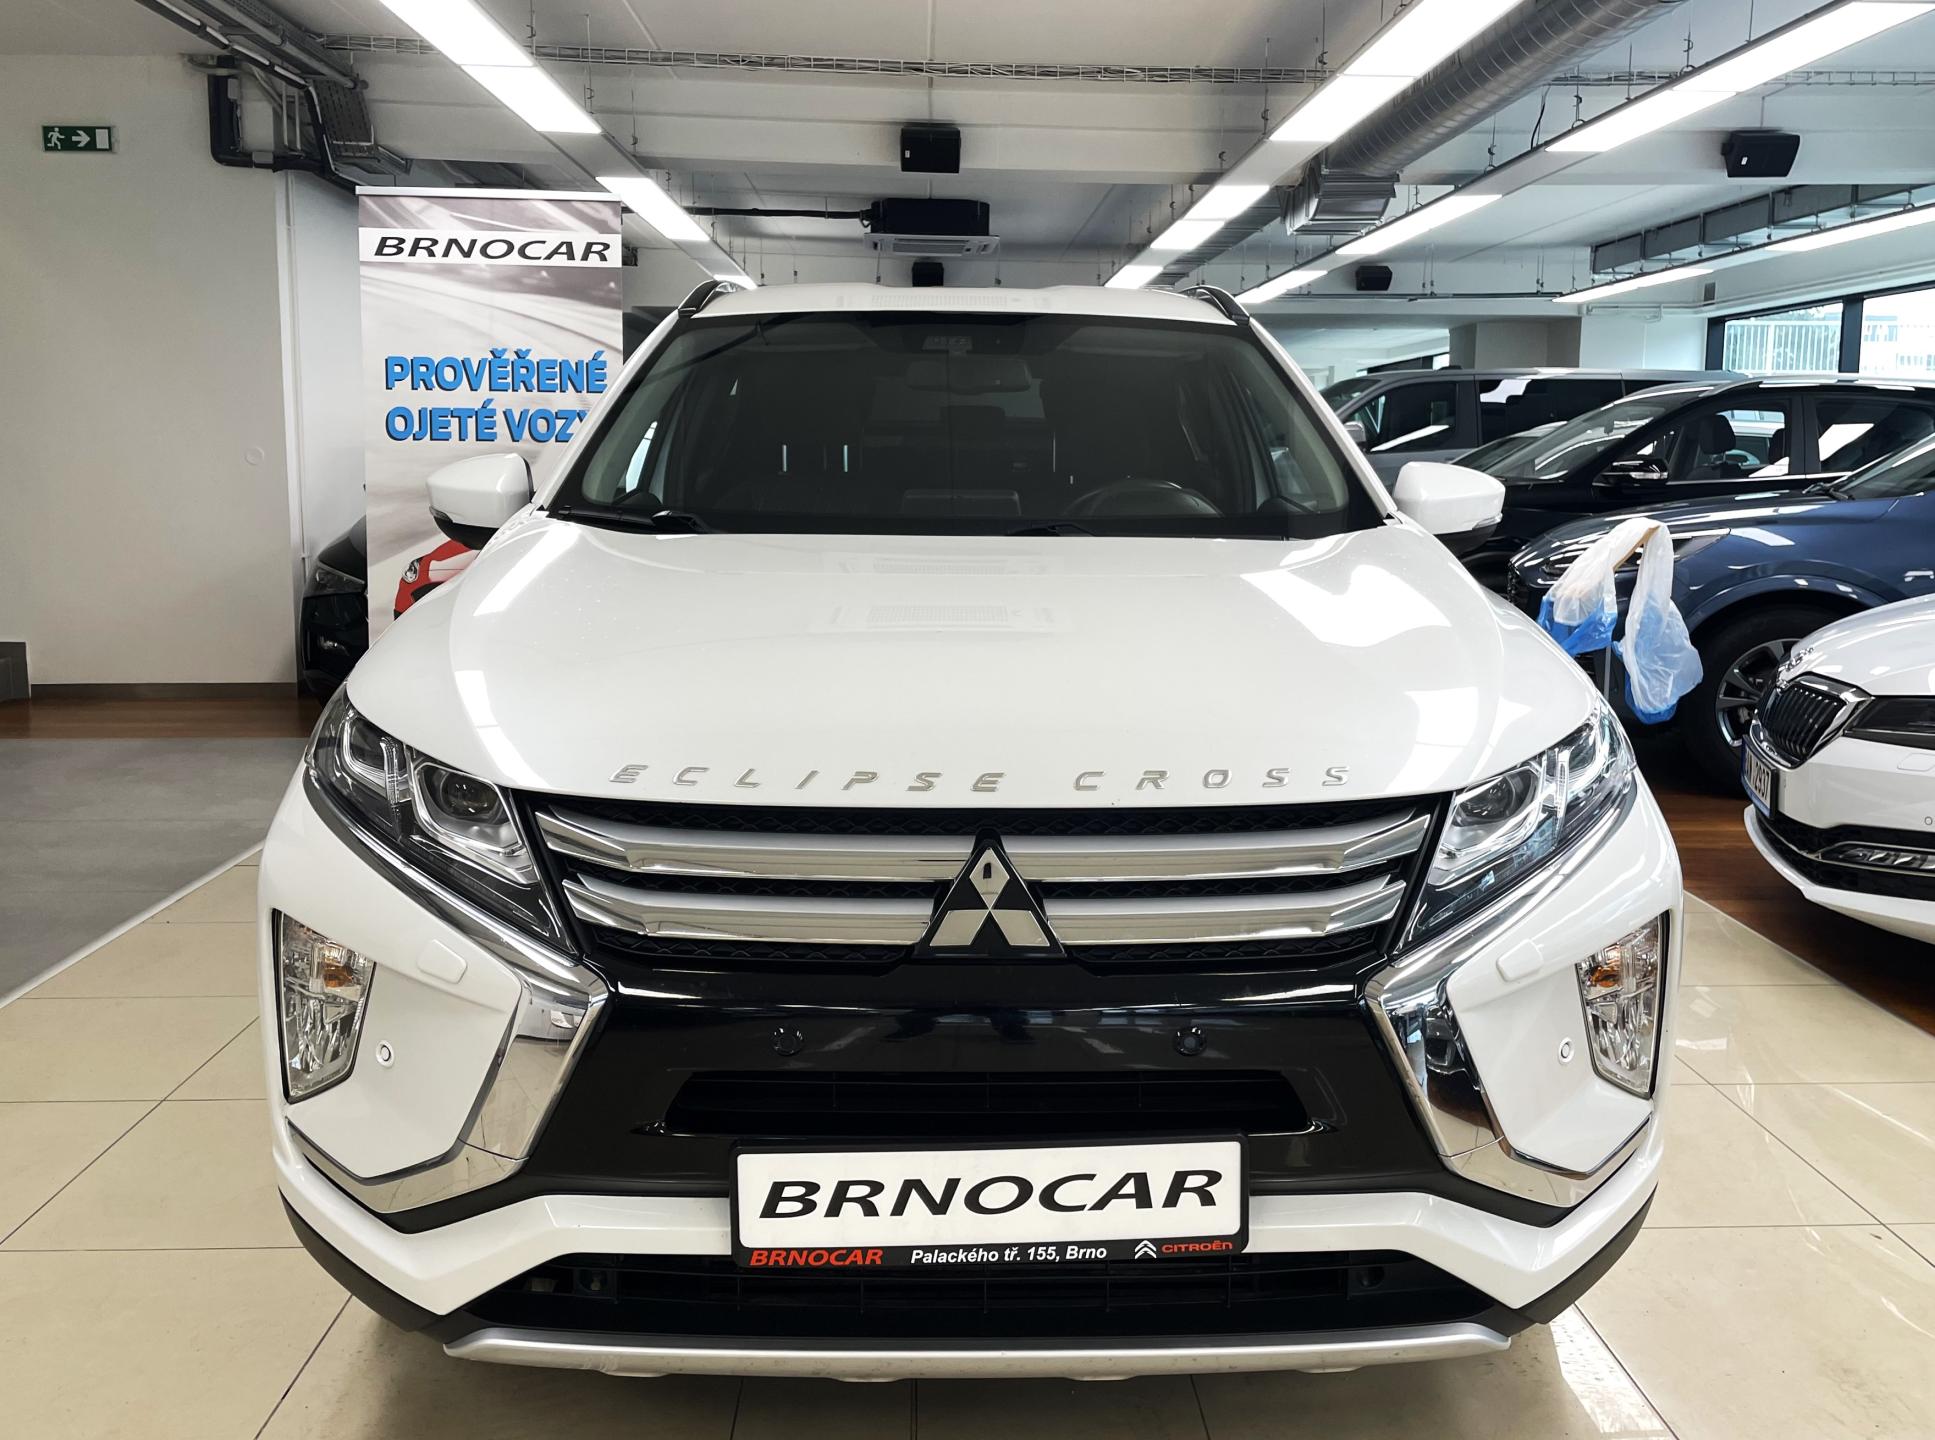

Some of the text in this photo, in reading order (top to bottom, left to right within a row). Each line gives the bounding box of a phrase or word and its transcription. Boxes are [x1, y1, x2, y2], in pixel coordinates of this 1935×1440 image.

[374, 236, 611, 262] BRNOCAR
[385, 348, 608, 393] PROVĚŘENÉ
[386, 398, 497, 442] OJETÉ
[608, 764, 1350, 792] ECLIPSE CROSS
[759, 1169, 1223, 1219] BRNOCAR
[749, 1248, 884, 1267] BRNOCAR
[910, 1244, 1108, 1264] Palackého tř. 155, Brno
[1161, 1240, 1234, 1254] CITROËN
